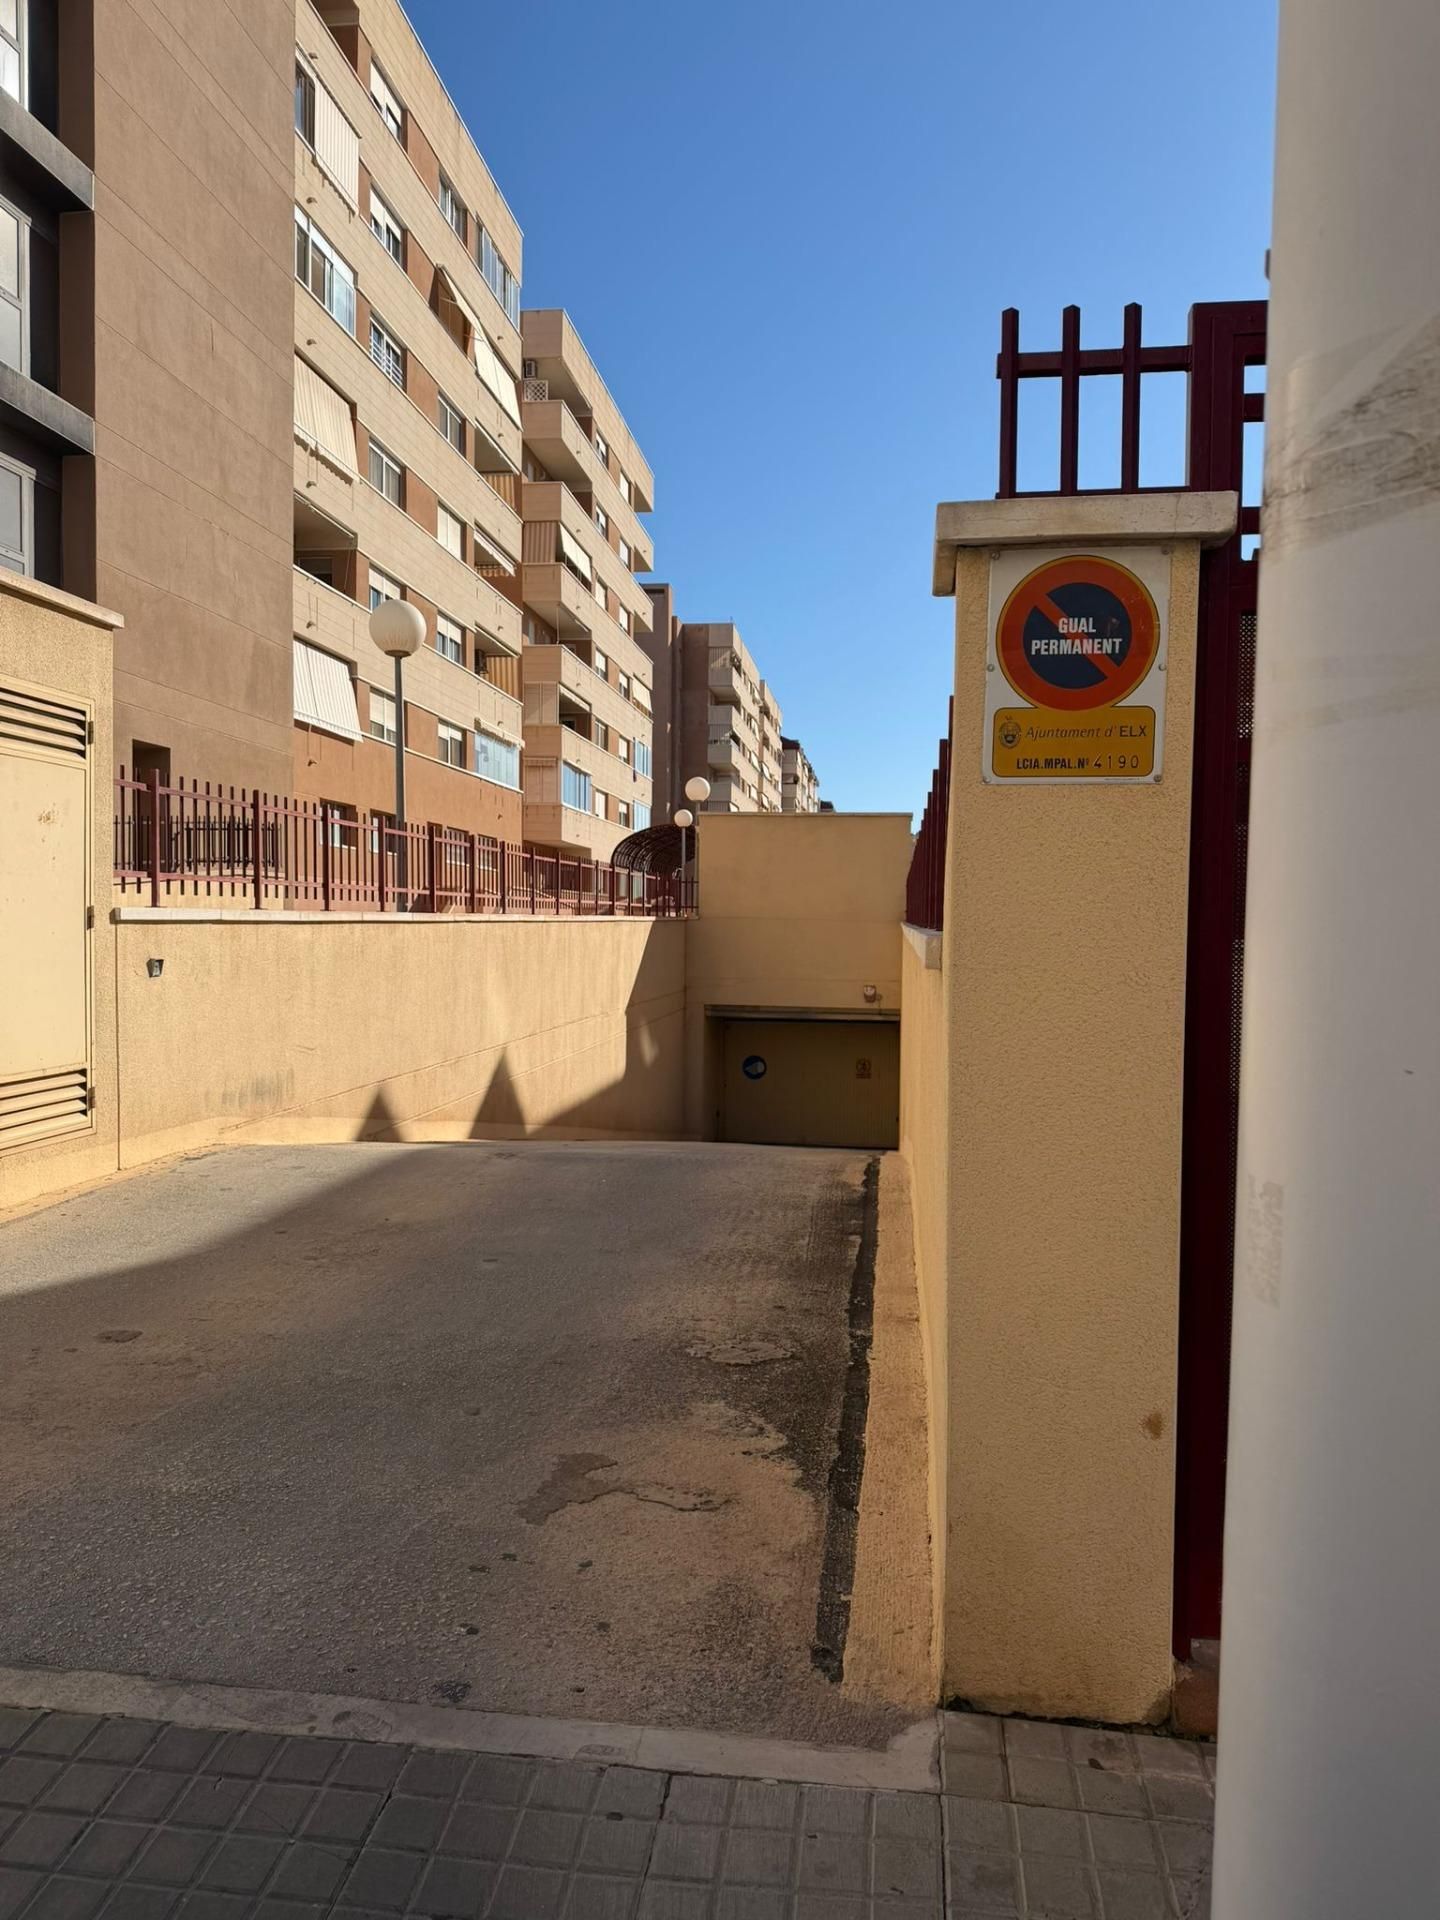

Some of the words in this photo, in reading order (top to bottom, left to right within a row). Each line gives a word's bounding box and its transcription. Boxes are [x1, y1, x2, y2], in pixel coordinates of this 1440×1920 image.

[1058, 617, 1097, 633] GUAL
[1031, 638, 1122, 655] PERMANENT
[1026, 726, 1100, 741] Ajuntament
[1093, 754, 1139, 769] 4190
